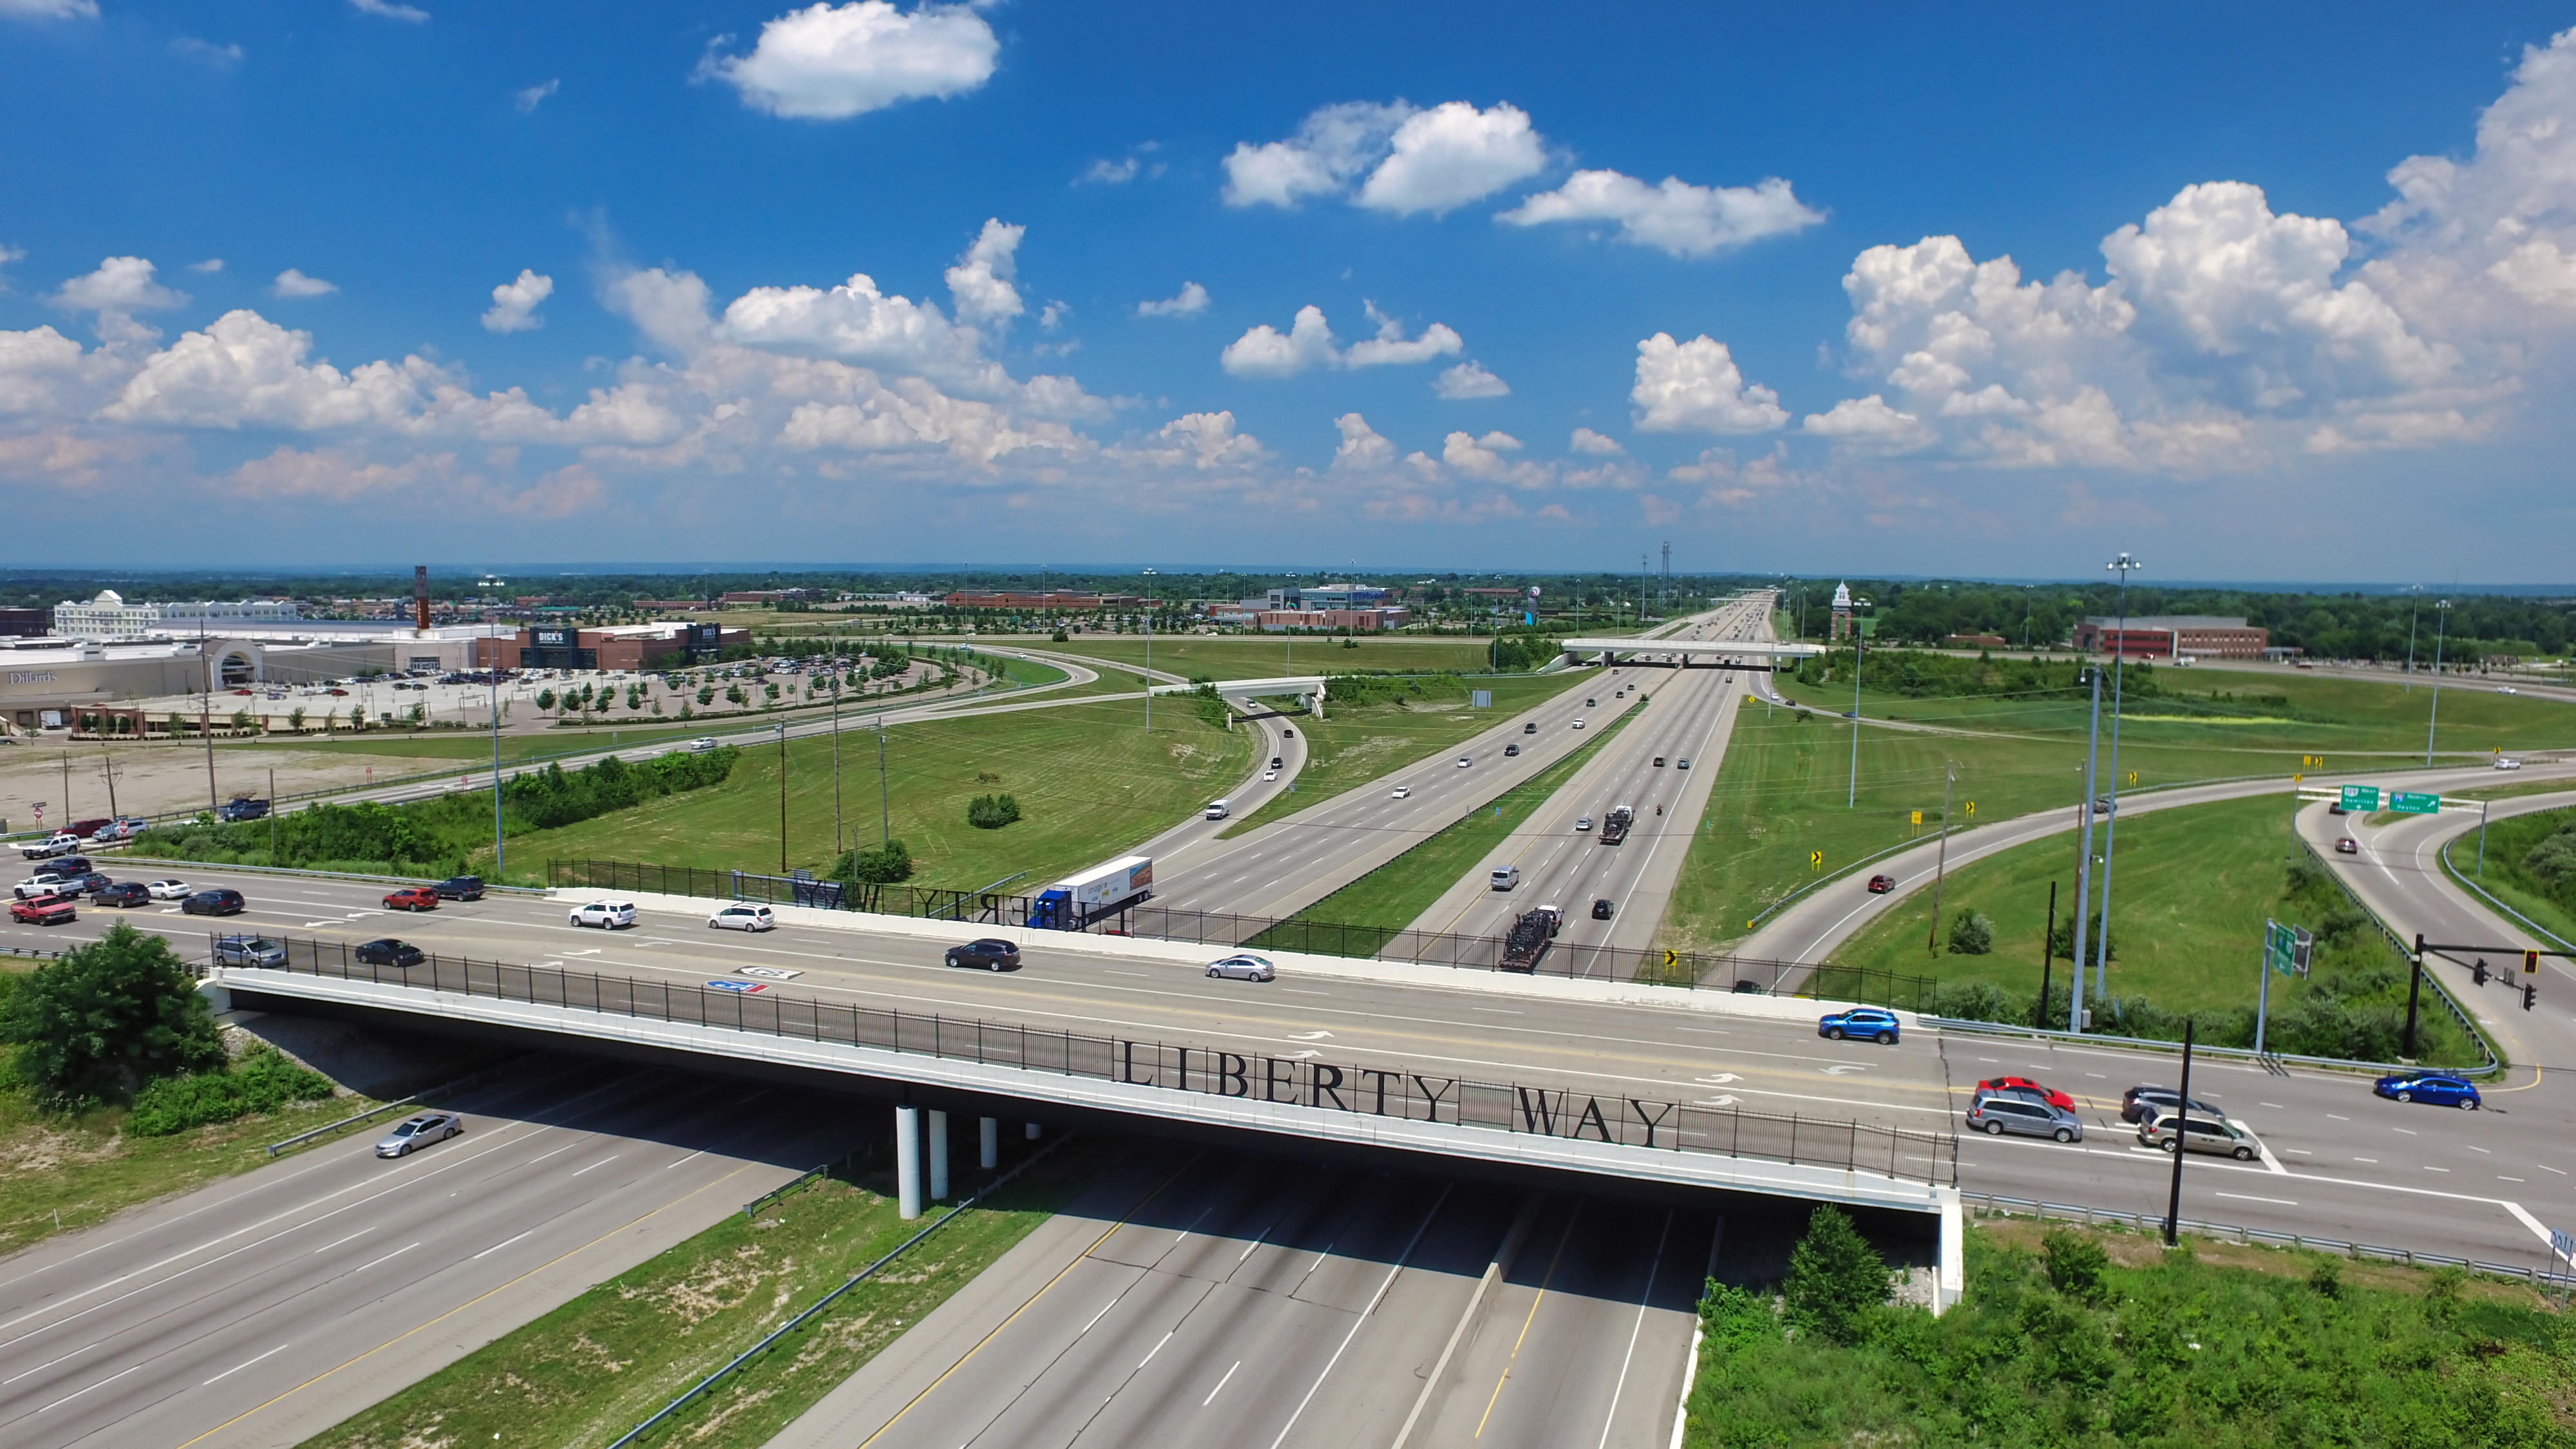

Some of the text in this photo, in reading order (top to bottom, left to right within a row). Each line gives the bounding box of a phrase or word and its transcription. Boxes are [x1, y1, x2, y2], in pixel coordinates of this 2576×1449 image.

[538, 630, 564, 641] DICK'S
[10, 671, 57, 685] Dillard's
[1122, 1039, 1674, 1149] LIBERTY WAY
